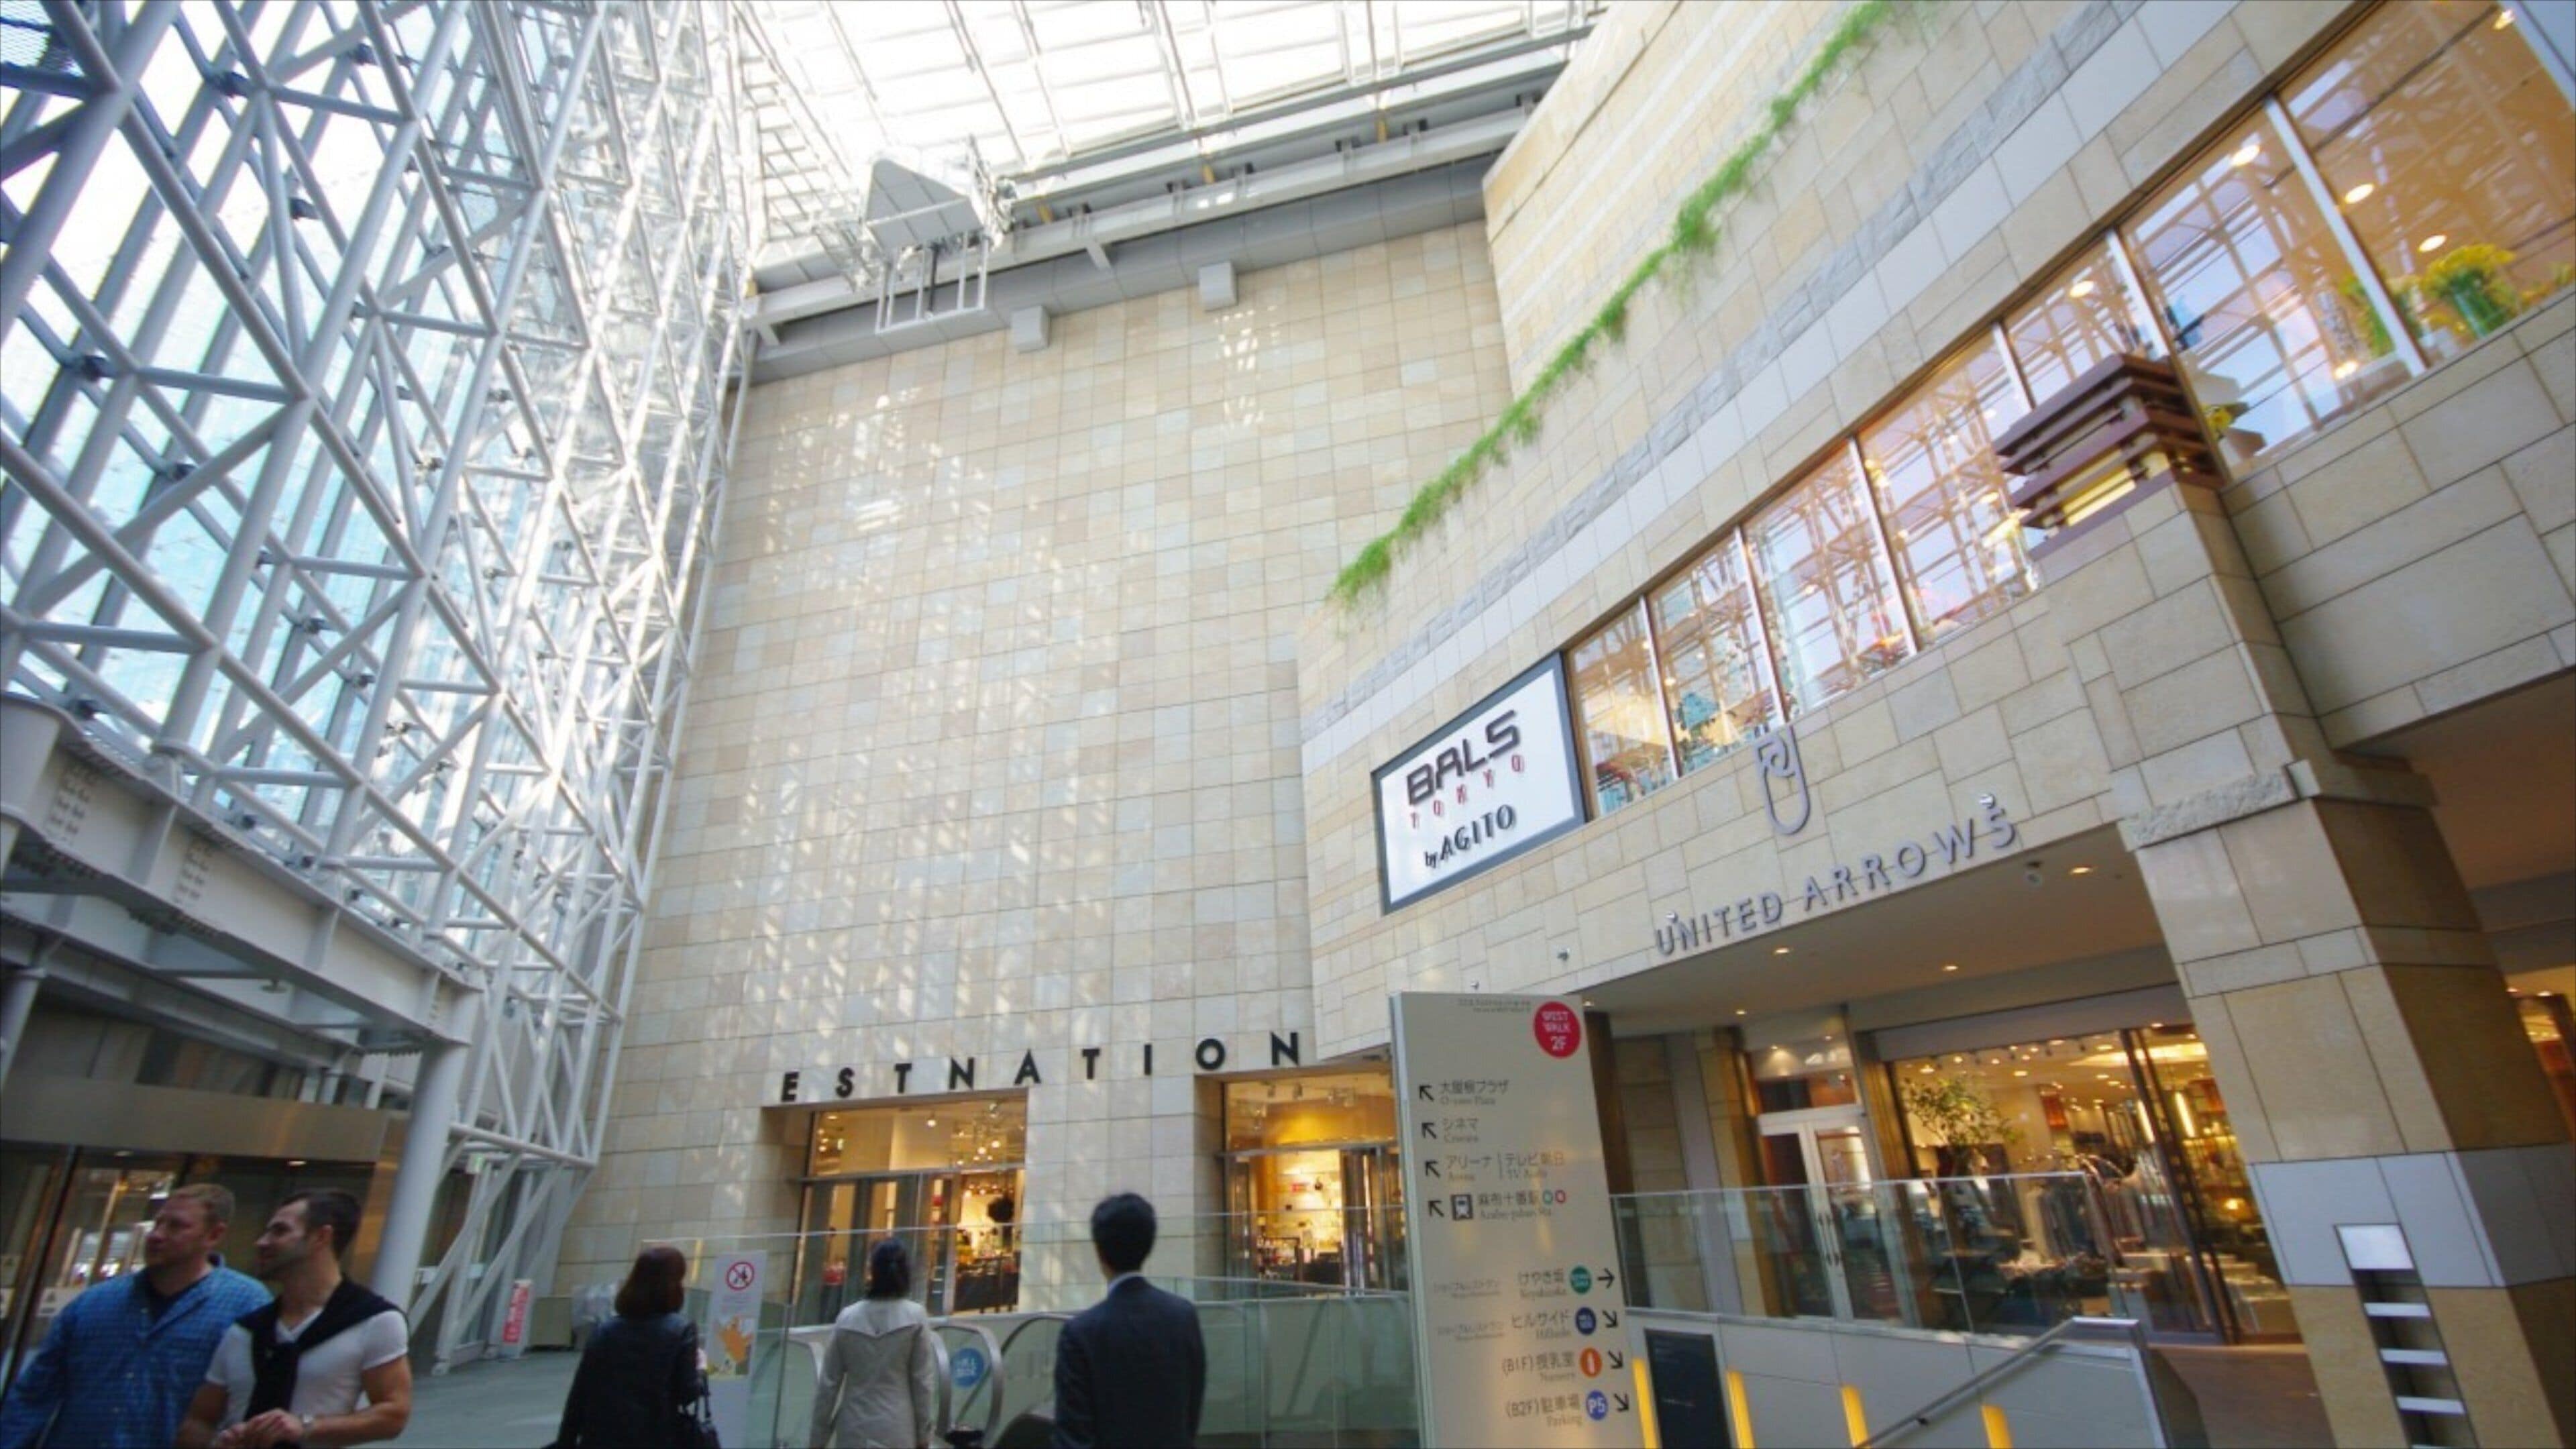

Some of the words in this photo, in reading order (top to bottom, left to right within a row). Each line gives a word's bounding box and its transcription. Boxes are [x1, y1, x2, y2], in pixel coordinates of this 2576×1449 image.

[1406, 709, 1521, 806] BALS
[1410, 753, 1525, 829] TOKYO
[1440, 804, 1516, 861] AGITO
[1655, 891, 1784, 957] UNITED
[1803, 805, 2018, 911] ARROWS
[780, 1030, 1300, 1102] ESTNATION
[1550, 1035, 1567, 1051] 2F
[1587, 1397, 1606, 1413] P5
